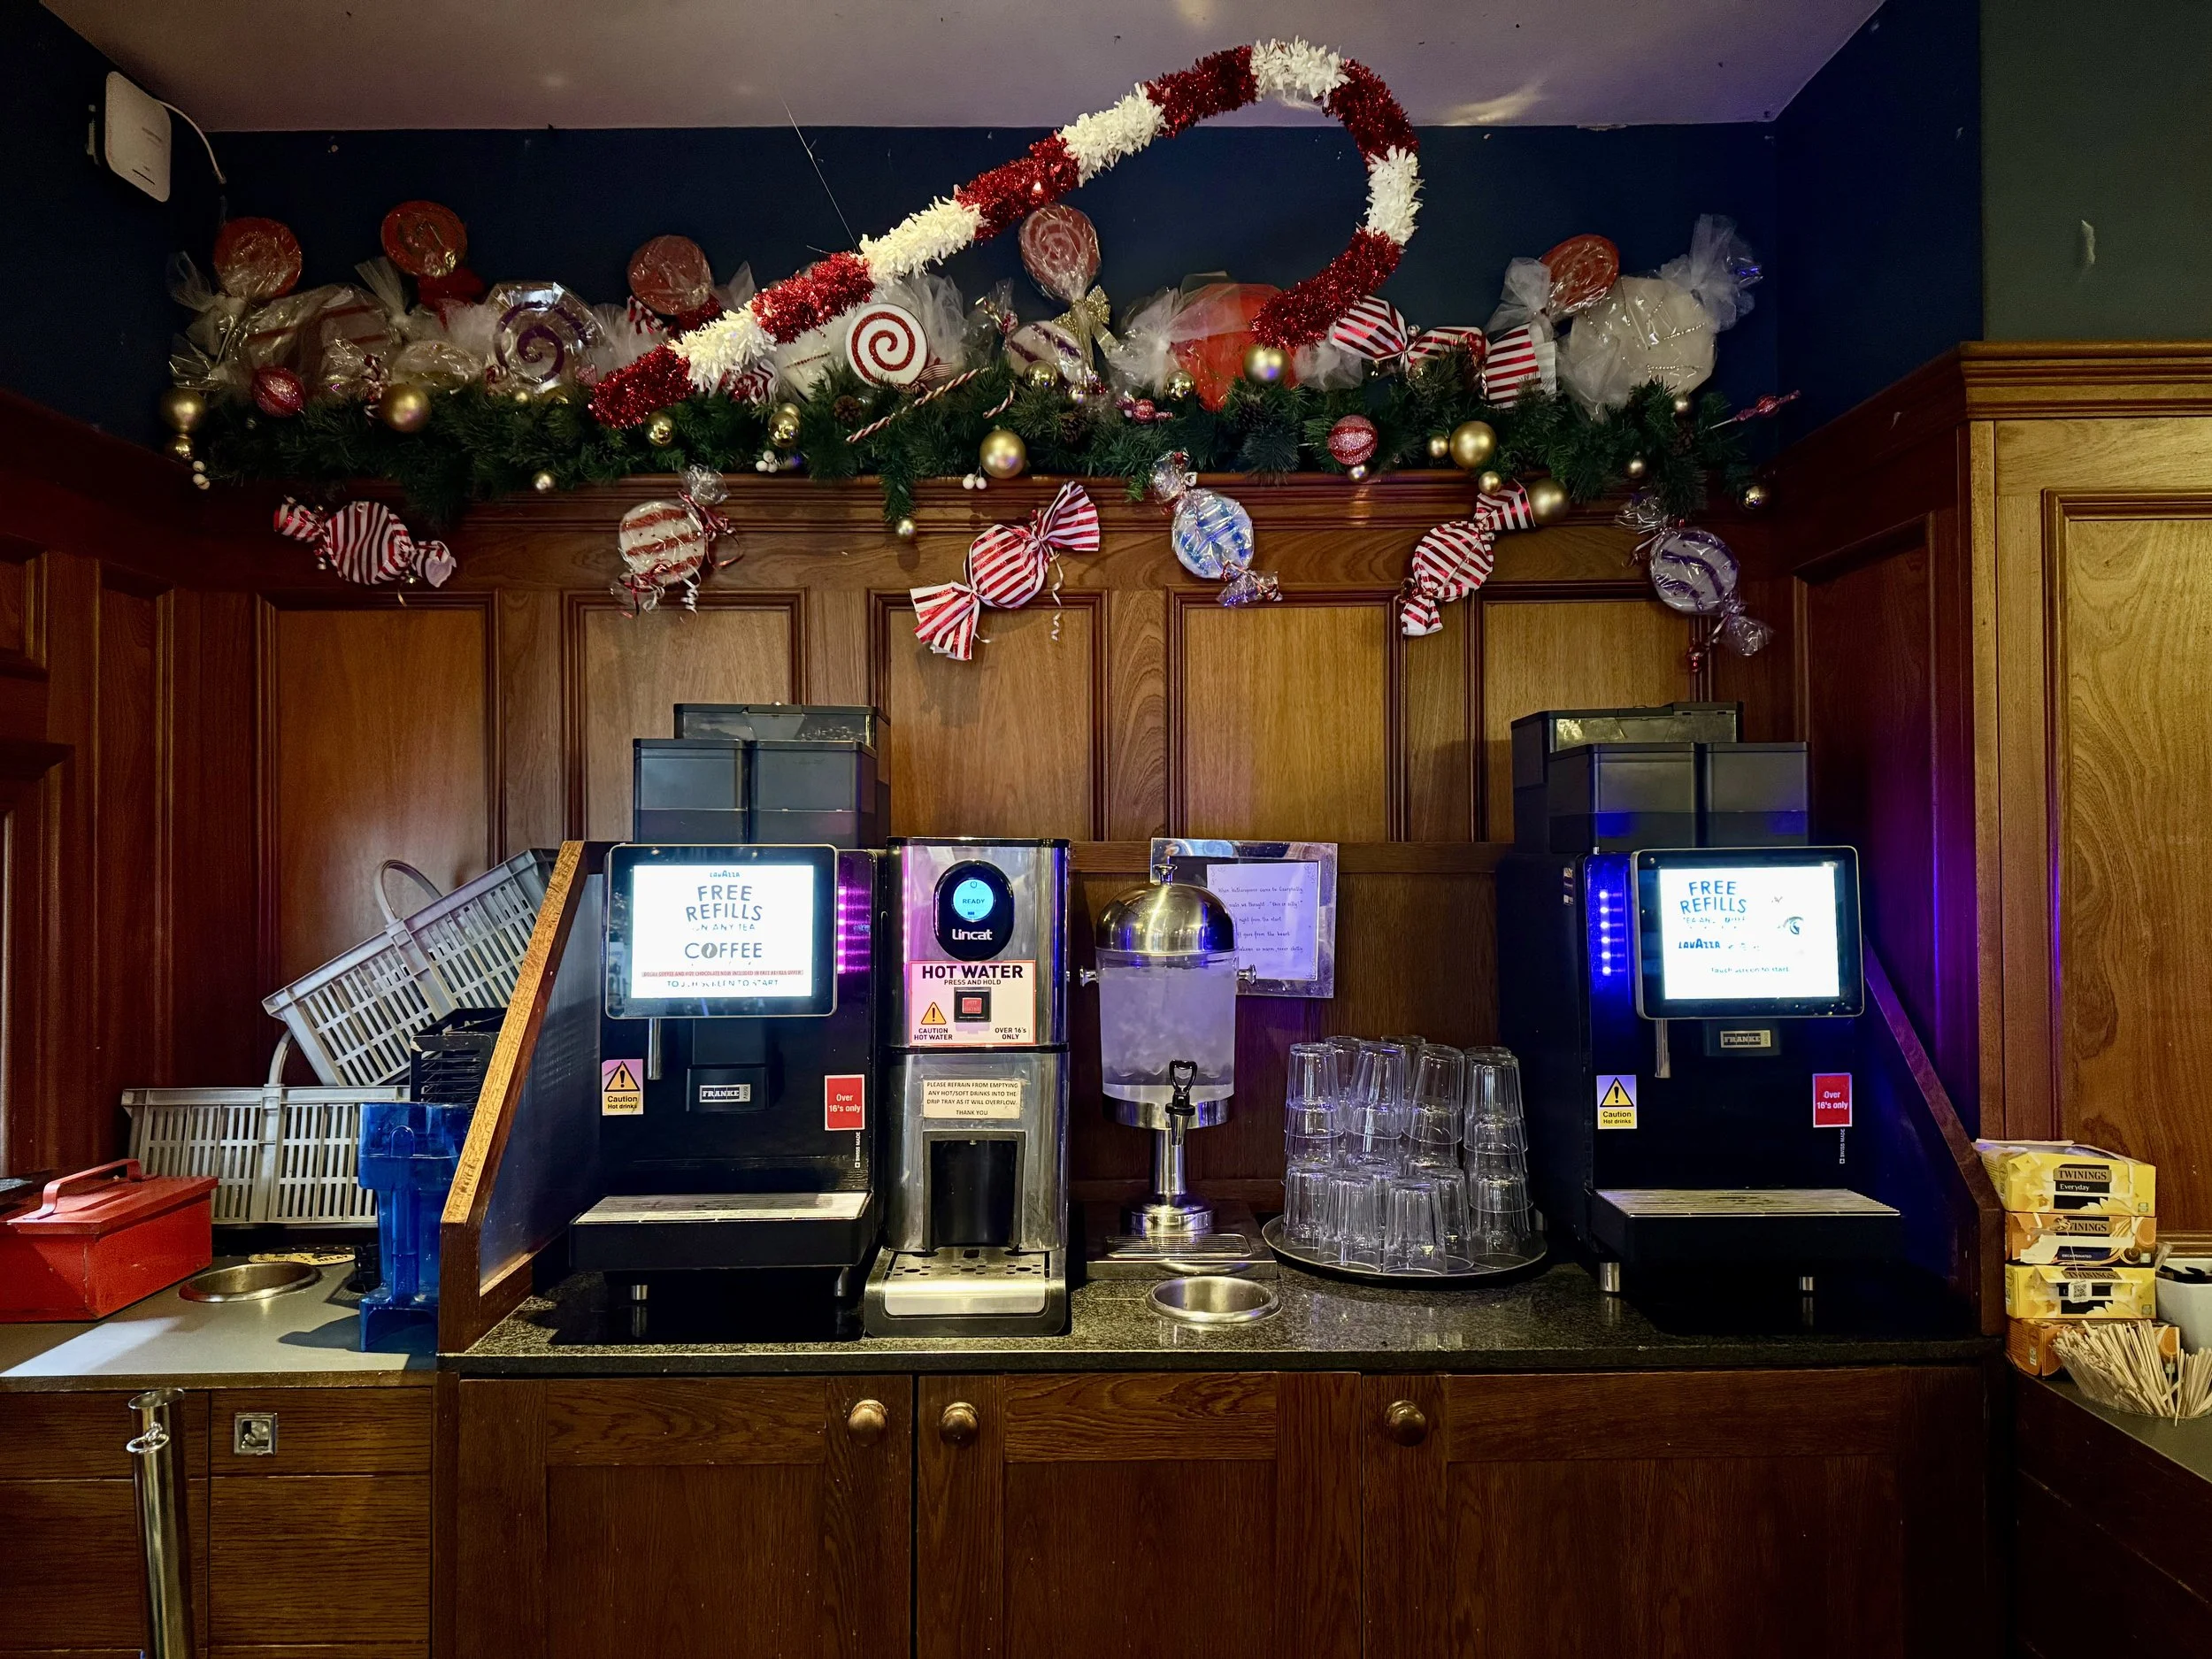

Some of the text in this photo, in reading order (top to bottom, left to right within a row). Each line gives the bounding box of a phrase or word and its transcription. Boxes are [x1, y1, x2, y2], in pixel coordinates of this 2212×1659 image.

[697, 885, 752, 902] FREE
[1688, 880, 1737, 896] FREE
[1679, 897, 1747, 915] REFILLS
[686, 902, 763, 922] REFILLS
[739, 923, 756, 932] TEA
[1678, 938, 1721, 949] LAVAZZA
[685, 942, 763, 959] COFFEE
[922, 965, 1024, 979] HOT WATER
[845, 1104, 861, 1113] only
[1832, 1101, 1848, 1110] only
[2058, 1170, 2107, 1180] TWININGS
[2060, 1183, 2090, 1192] Everyday
[2068, 1221, 2108, 1232] WININGS
